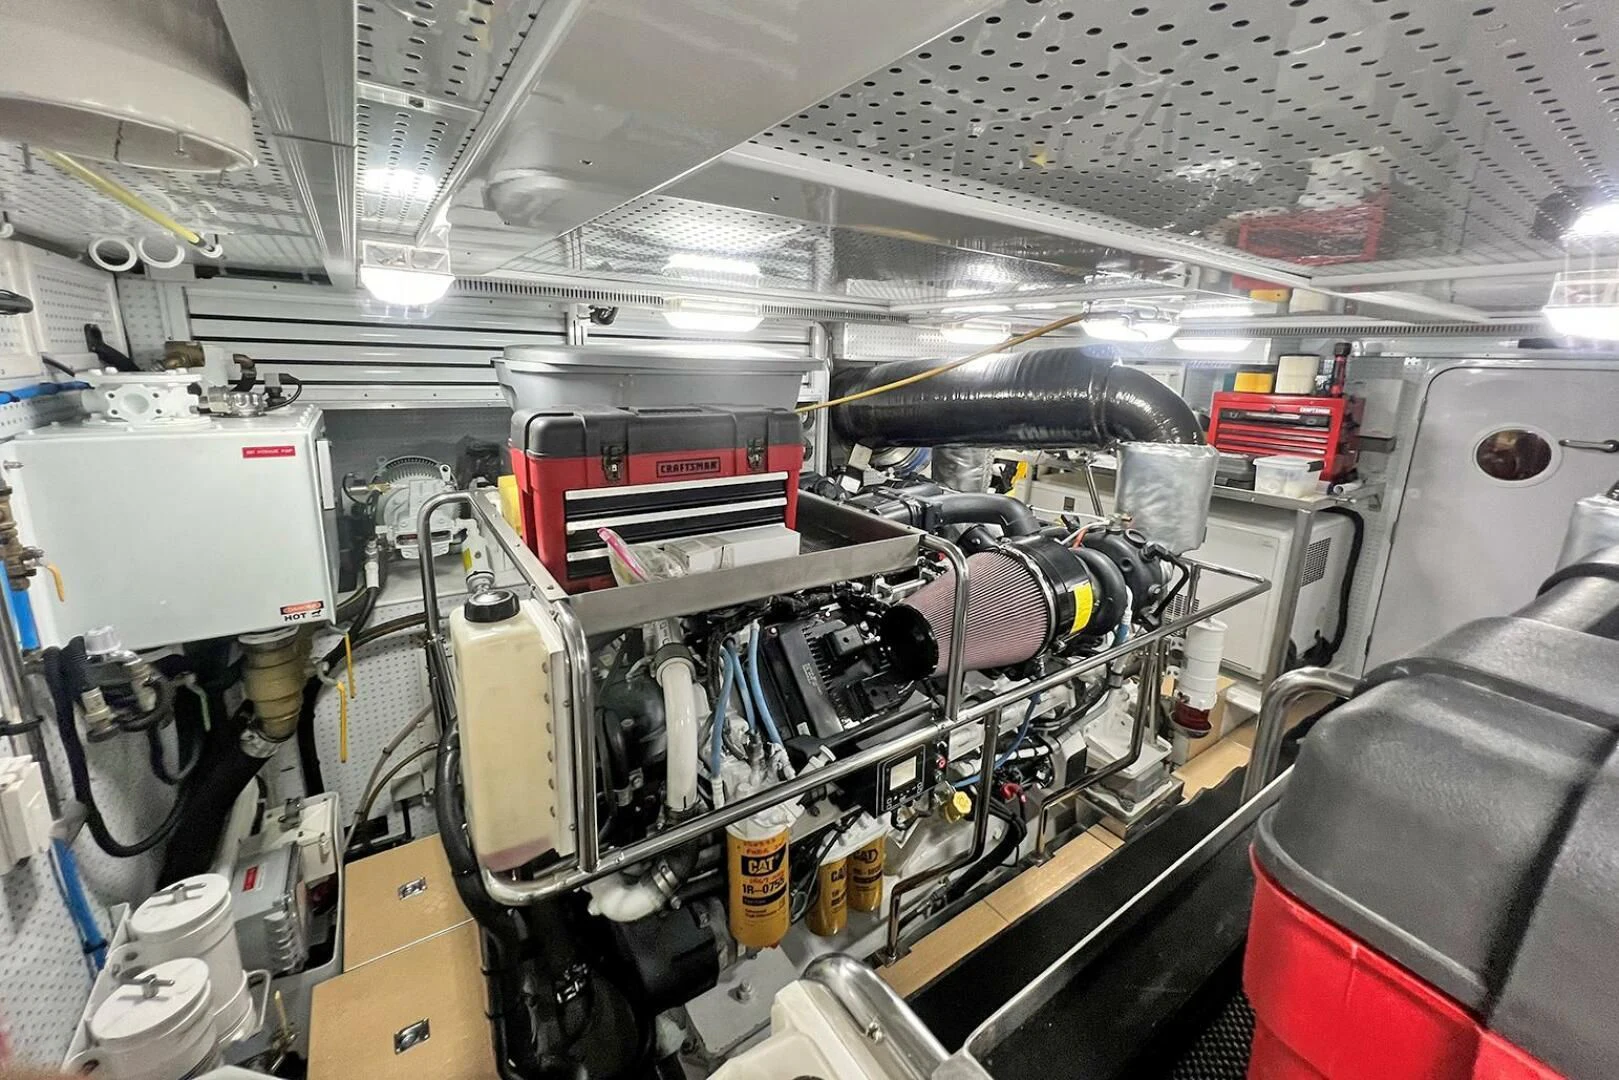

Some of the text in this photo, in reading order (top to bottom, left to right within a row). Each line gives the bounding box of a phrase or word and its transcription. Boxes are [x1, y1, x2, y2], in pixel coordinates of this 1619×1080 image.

[660, 460, 718, 473] CRAFTSMAN
[284, 612, 307, 621] HOT
[748, 857, 775, 875] CAT
